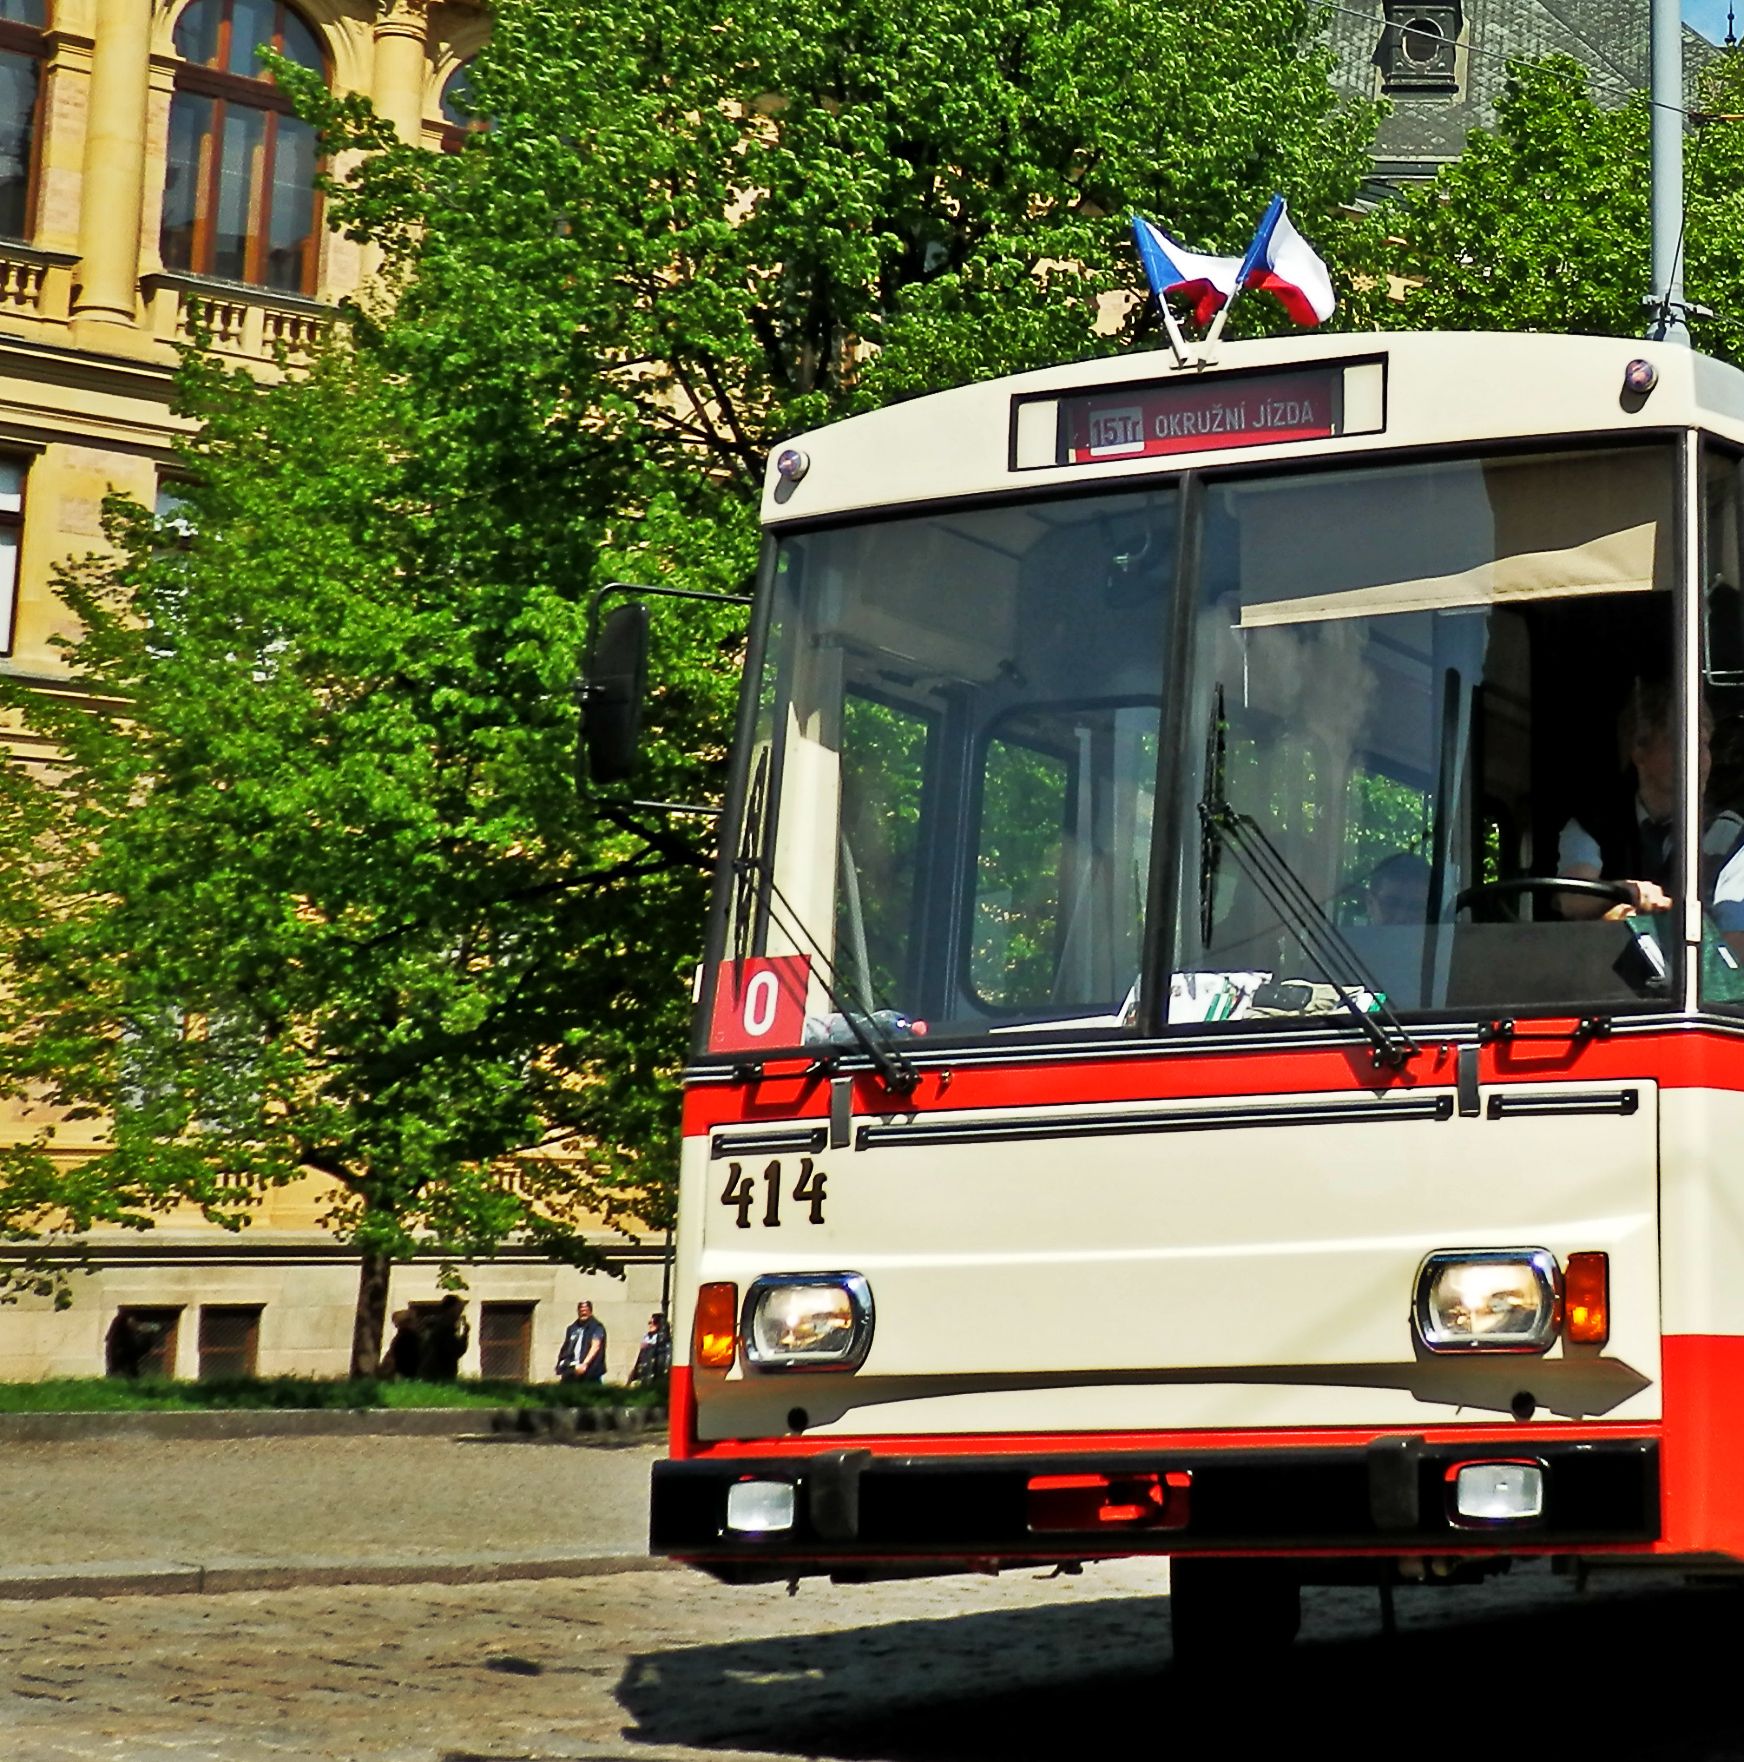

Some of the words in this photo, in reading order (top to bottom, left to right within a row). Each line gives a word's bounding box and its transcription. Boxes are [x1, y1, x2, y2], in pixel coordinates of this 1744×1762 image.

[1092, 416, 1141, 447] 15Tr
[1155, 402, 1245, 437] OKRUŽNÍ
[1252, 398, 1314, 428] JÍZDA
[720, 1158, 828, 1229] 414
